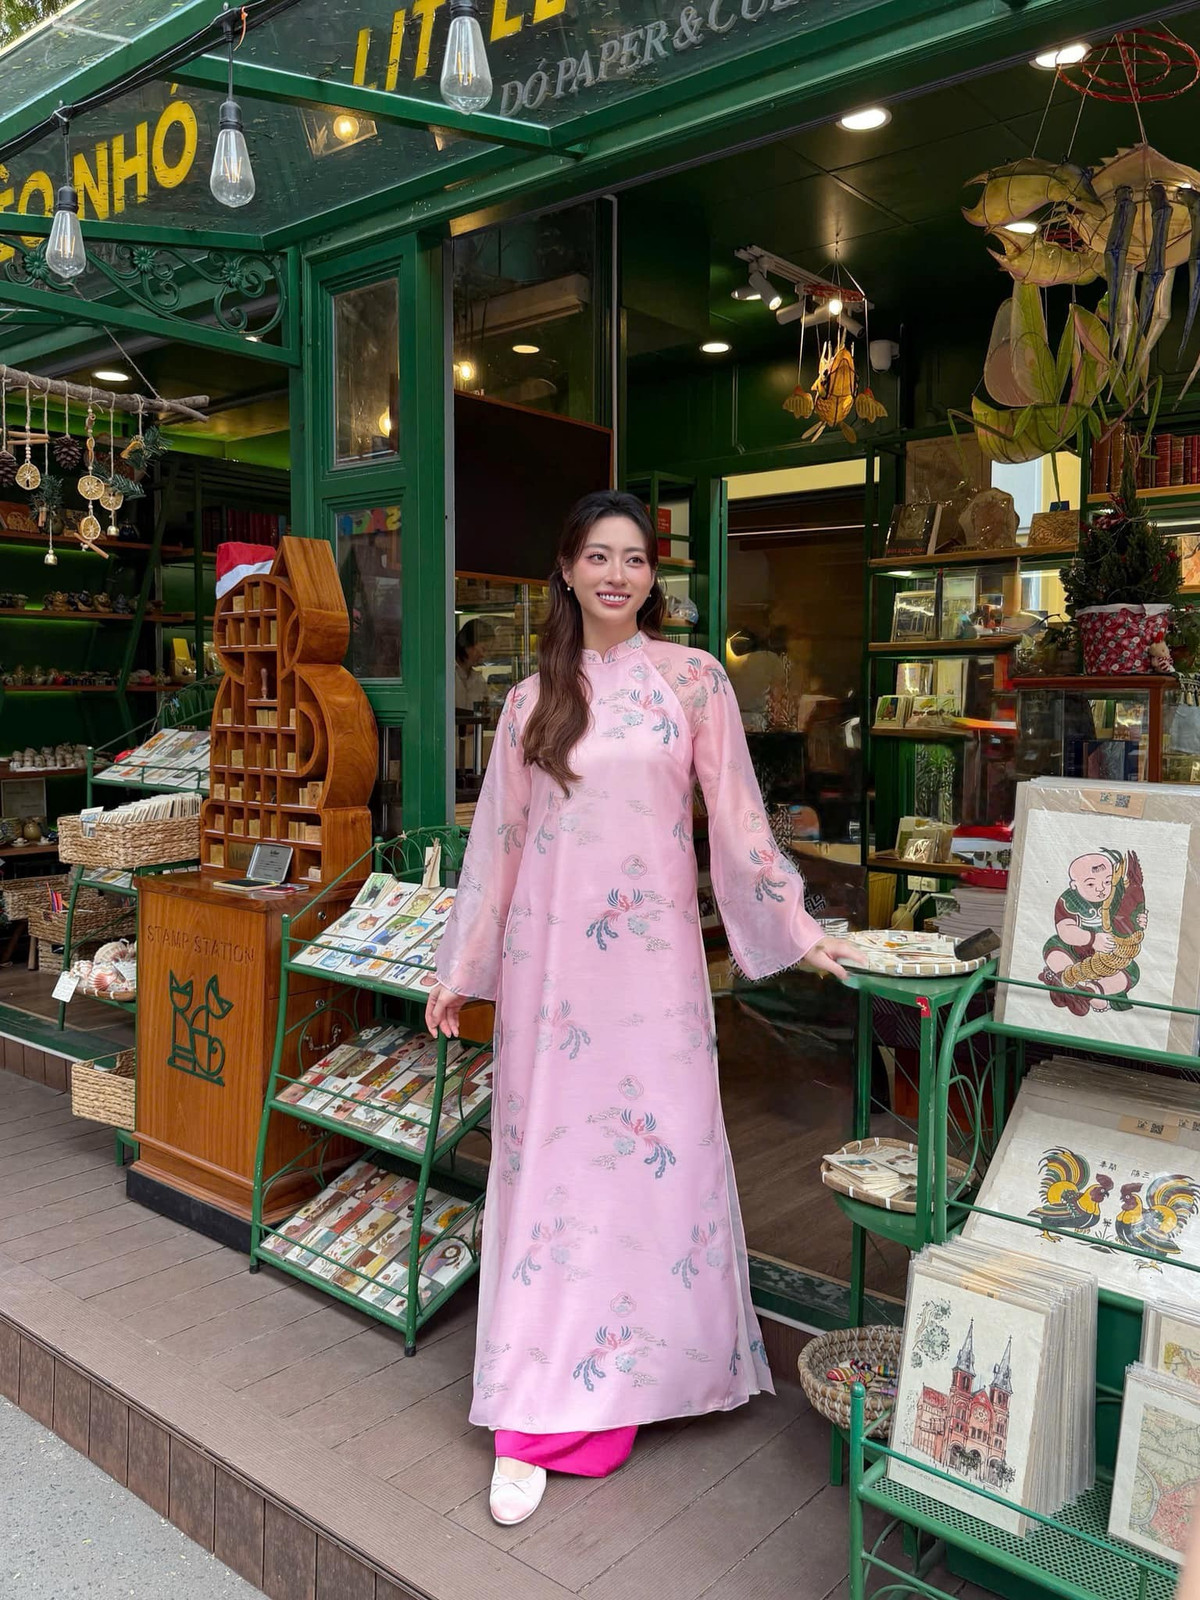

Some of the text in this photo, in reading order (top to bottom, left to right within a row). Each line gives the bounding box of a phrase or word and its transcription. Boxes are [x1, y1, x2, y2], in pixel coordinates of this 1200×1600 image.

[353, 0, 566, 91] LITL
[552, 20, 670, 99] PAPER
[147, 925, 254, 963] STAMP STATION
